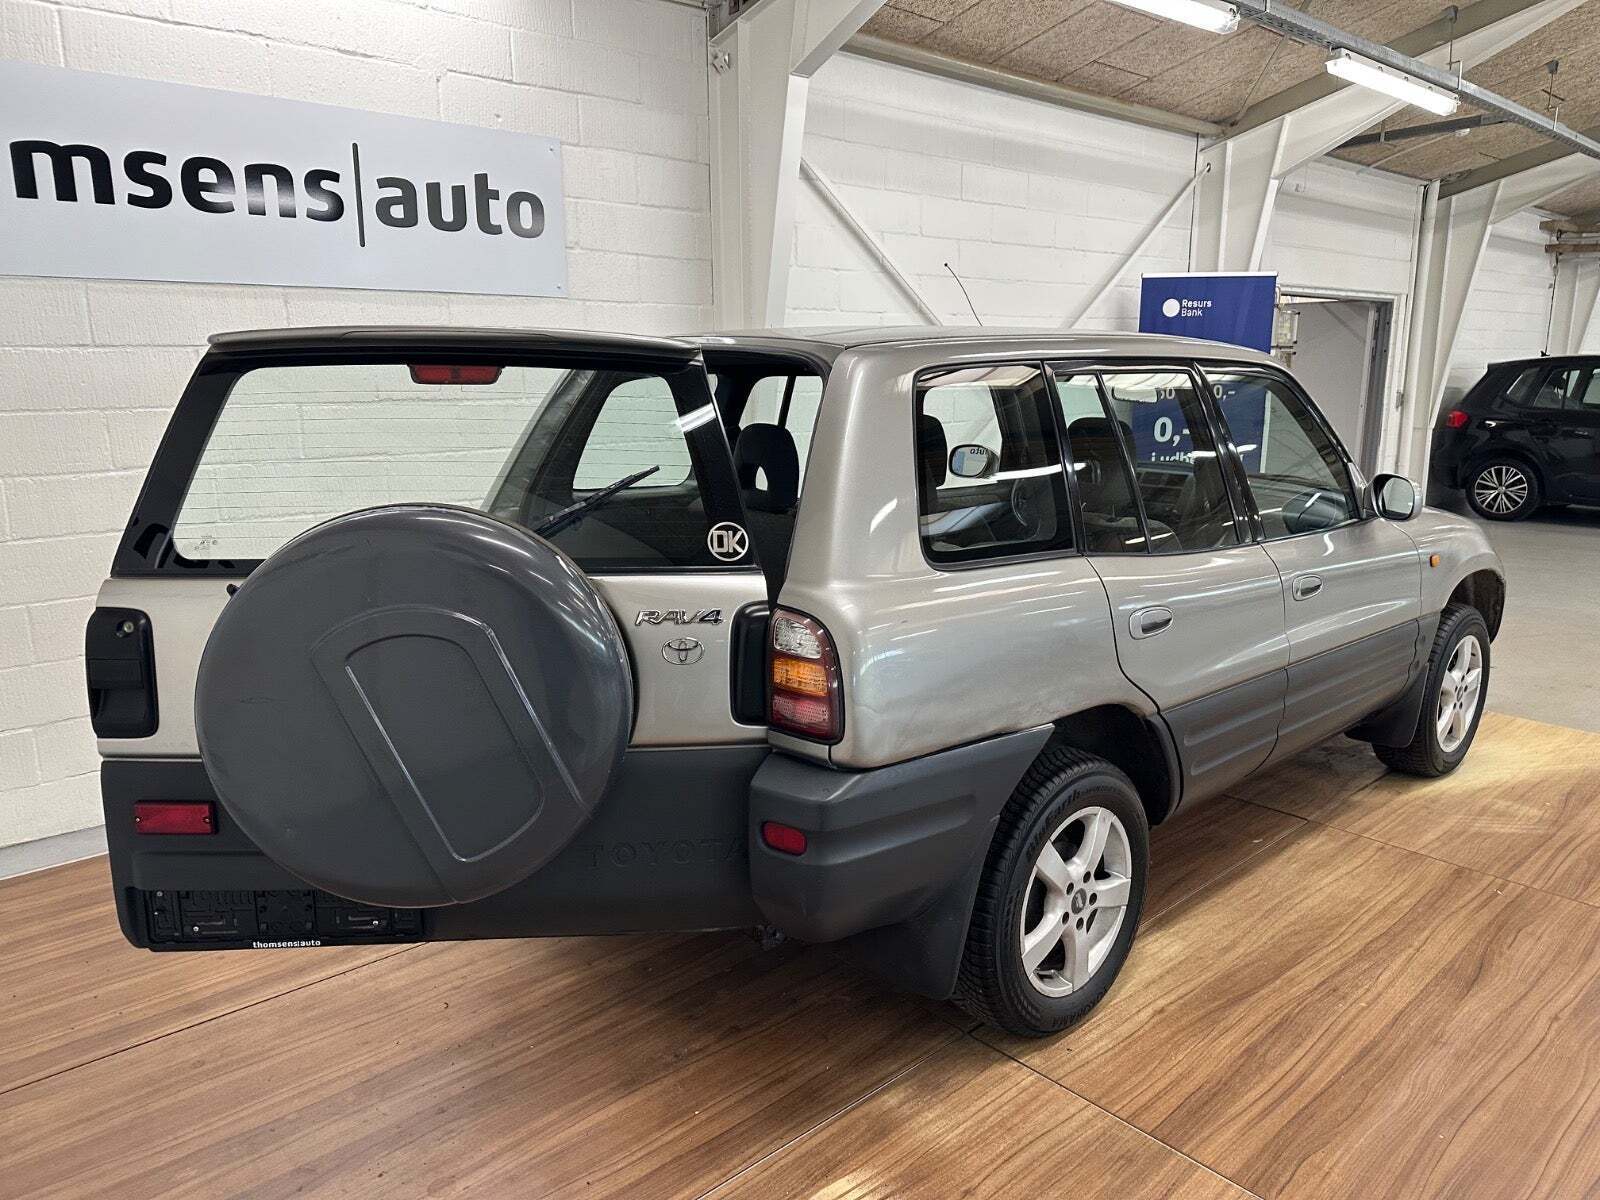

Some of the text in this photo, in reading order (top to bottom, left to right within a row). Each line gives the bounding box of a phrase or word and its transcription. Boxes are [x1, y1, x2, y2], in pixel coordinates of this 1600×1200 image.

[1181, 299, 1212, 308] Resurs
[1181, 308, 1203, 317] Bank
[635, 608, 724, 627] RAV4
